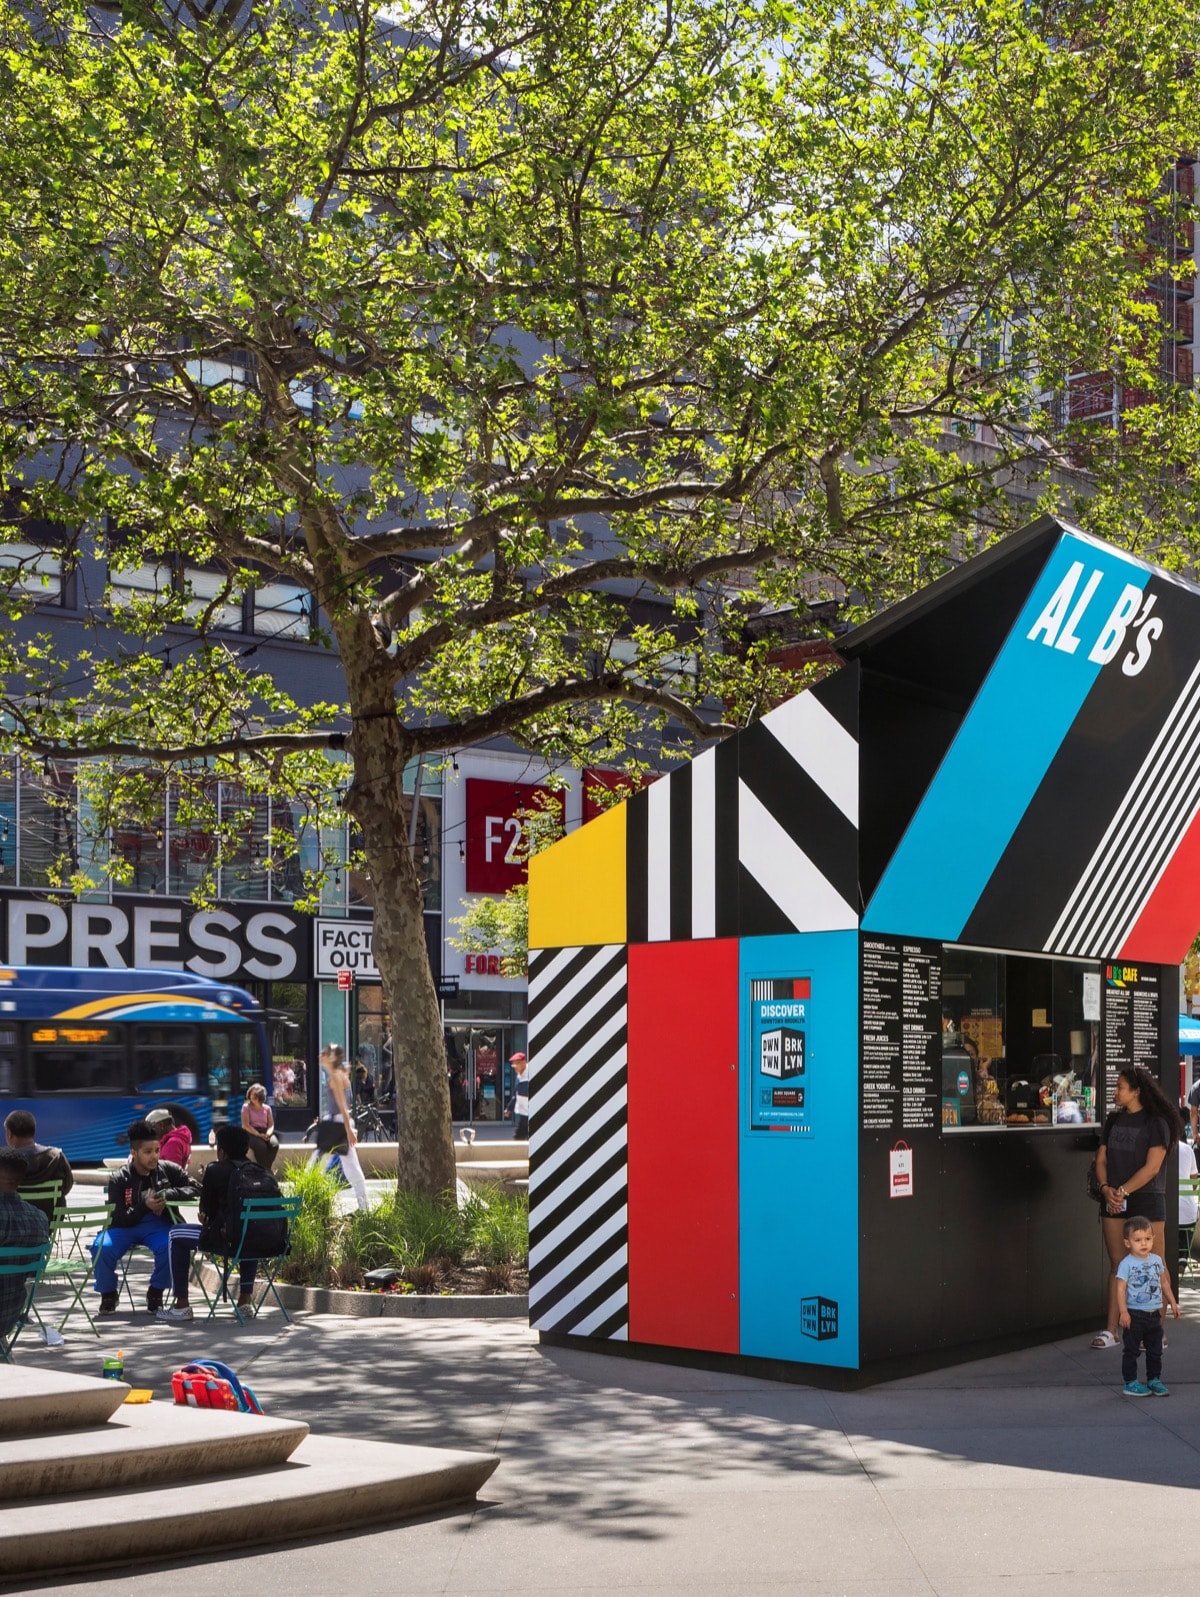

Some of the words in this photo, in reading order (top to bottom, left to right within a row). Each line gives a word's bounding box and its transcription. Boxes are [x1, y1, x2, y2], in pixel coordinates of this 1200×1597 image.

[1026, 560, 1104, 655] AL
[1088, 583, 1163, 677] B's
[322, 930, 373, 949] FACT
[330, 950, 379, 969] OUT
[1123, 966, 1138, 982] CAFE
[761, 1004, 805, 1017] DISCOVER
[763, 1037, 779, 1052] DWN
[784, 1037, 803, 1052] BRK
[763, 1055, 779, 1070] TWN
[784, 1055, 803, 1070] LYN
[802, 1304, 817, 1317] DWN
[820, 1304, 837, 1319] BRK
[802, 1318, 817, 1332] TWN
[820, 1320, 837, 1333] LYN
